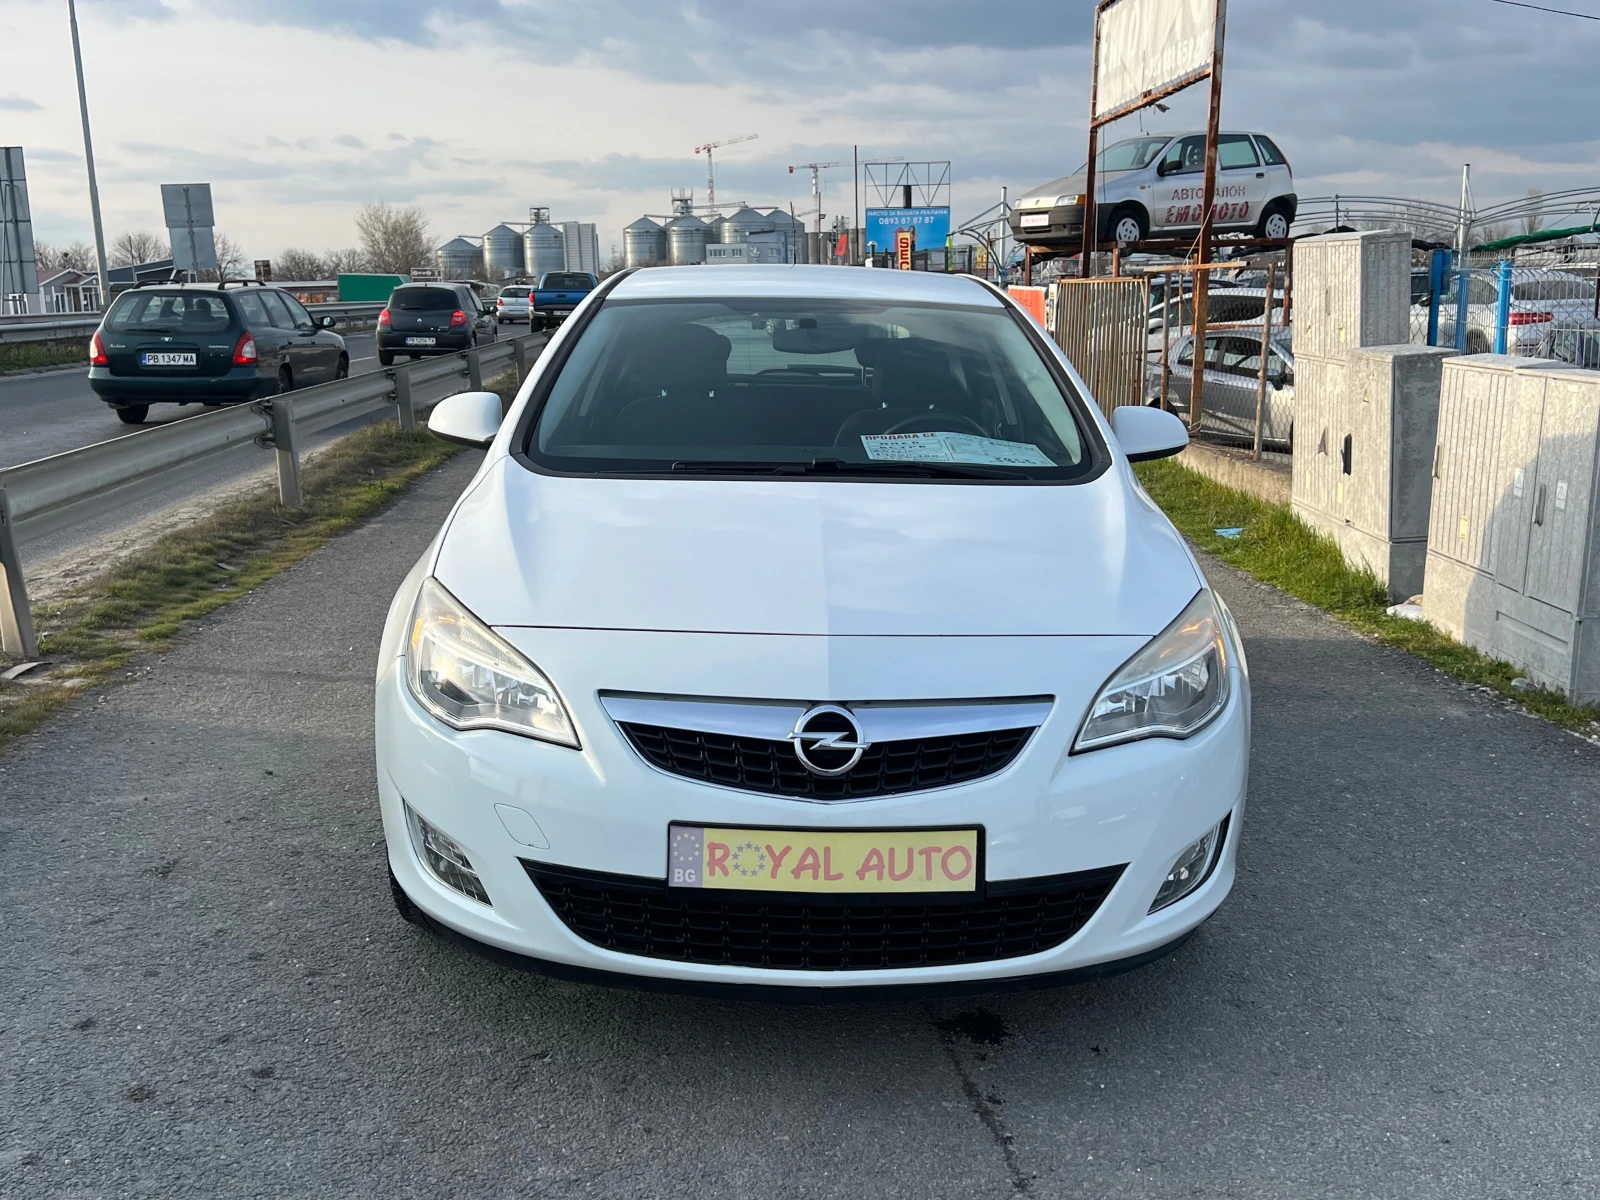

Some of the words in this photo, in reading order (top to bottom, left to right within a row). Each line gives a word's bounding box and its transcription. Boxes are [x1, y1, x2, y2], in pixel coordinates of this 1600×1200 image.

[1171, 186, 1246, 201] АВТОАЛОН
[878, 217, 899, 225] 0893
[901, 217, 910, 225] 87
[924, 216, 934, 224] 87
[147, 354, 159, 364] PB
[161, 354, 181, 364] 1347
[183, 354, 195, 364] MA
[706, 841, 844, 881] ROYAL
[855, 845, 973, 882] AUTO
[673, 868, 696, 883] BG
